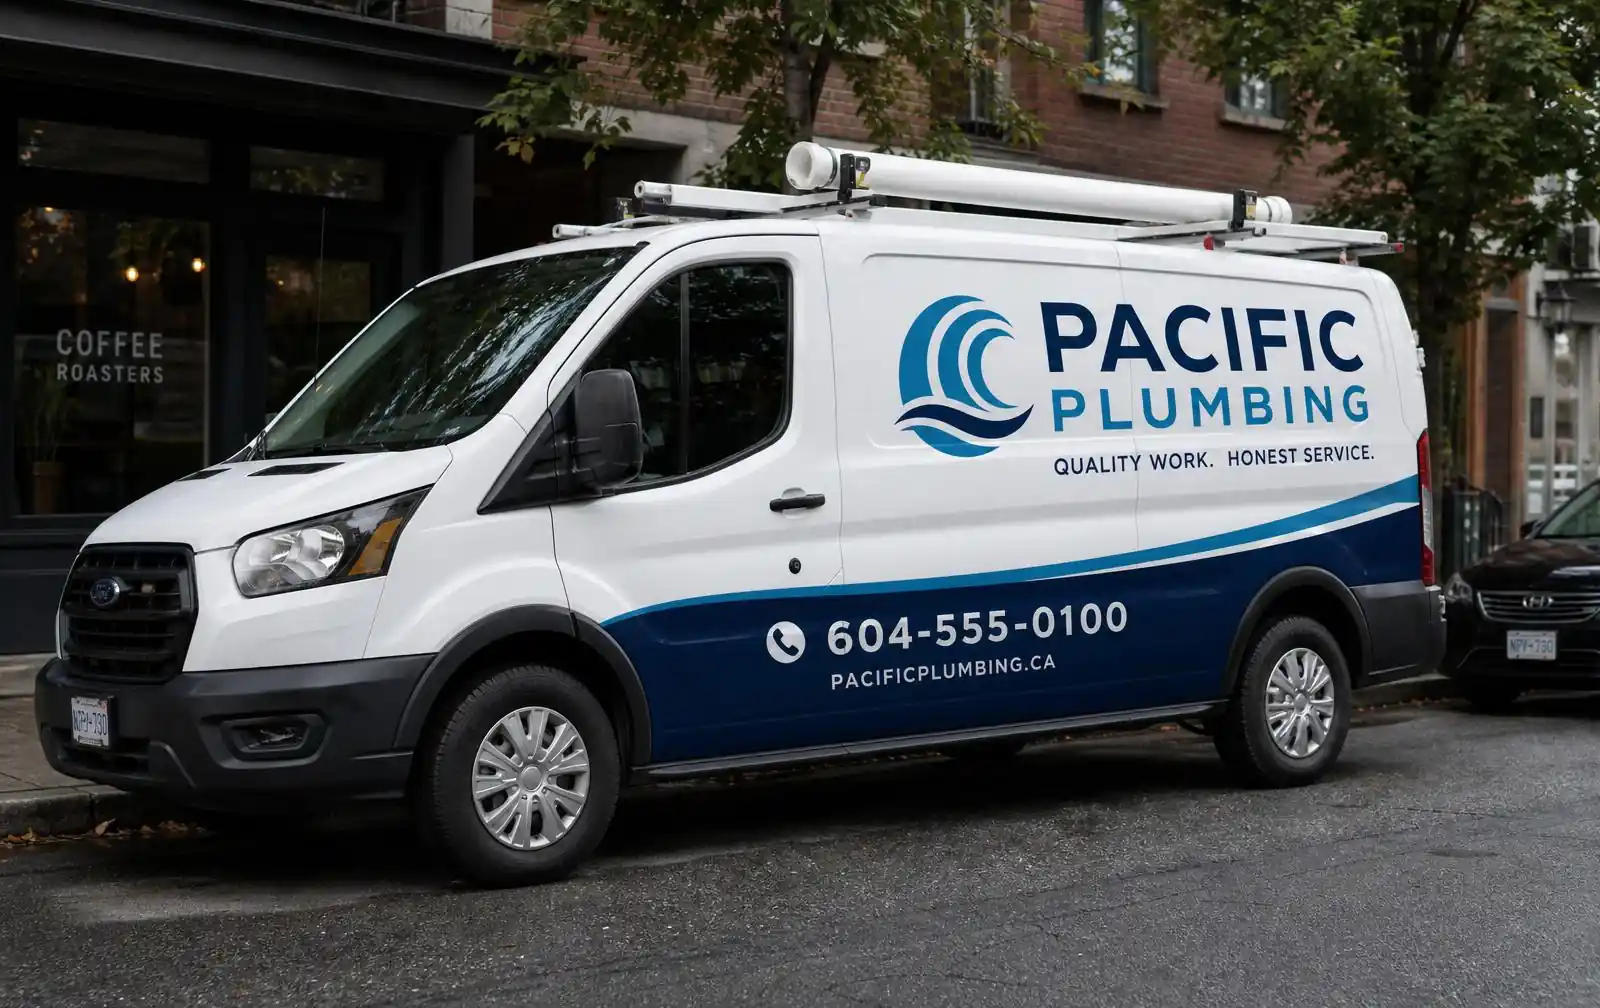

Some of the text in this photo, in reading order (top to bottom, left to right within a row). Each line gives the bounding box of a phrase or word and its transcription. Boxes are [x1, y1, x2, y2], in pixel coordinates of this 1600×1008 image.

[57, 329, 162, 358] COFFEE
[1040, 301, 1364, 373] PACIFIC
[57, 363, 163, 383] ROASTERS
[1052, 384, 1369, 432] PLUMBING
[1053, 444, 1375, 476] QUALITY WORK. HONEST SERVICE.
[827, 601, 1128, 656] 604-555-0100
[831, 654, 1056, 691] PACIFICPLUMBING.CA
